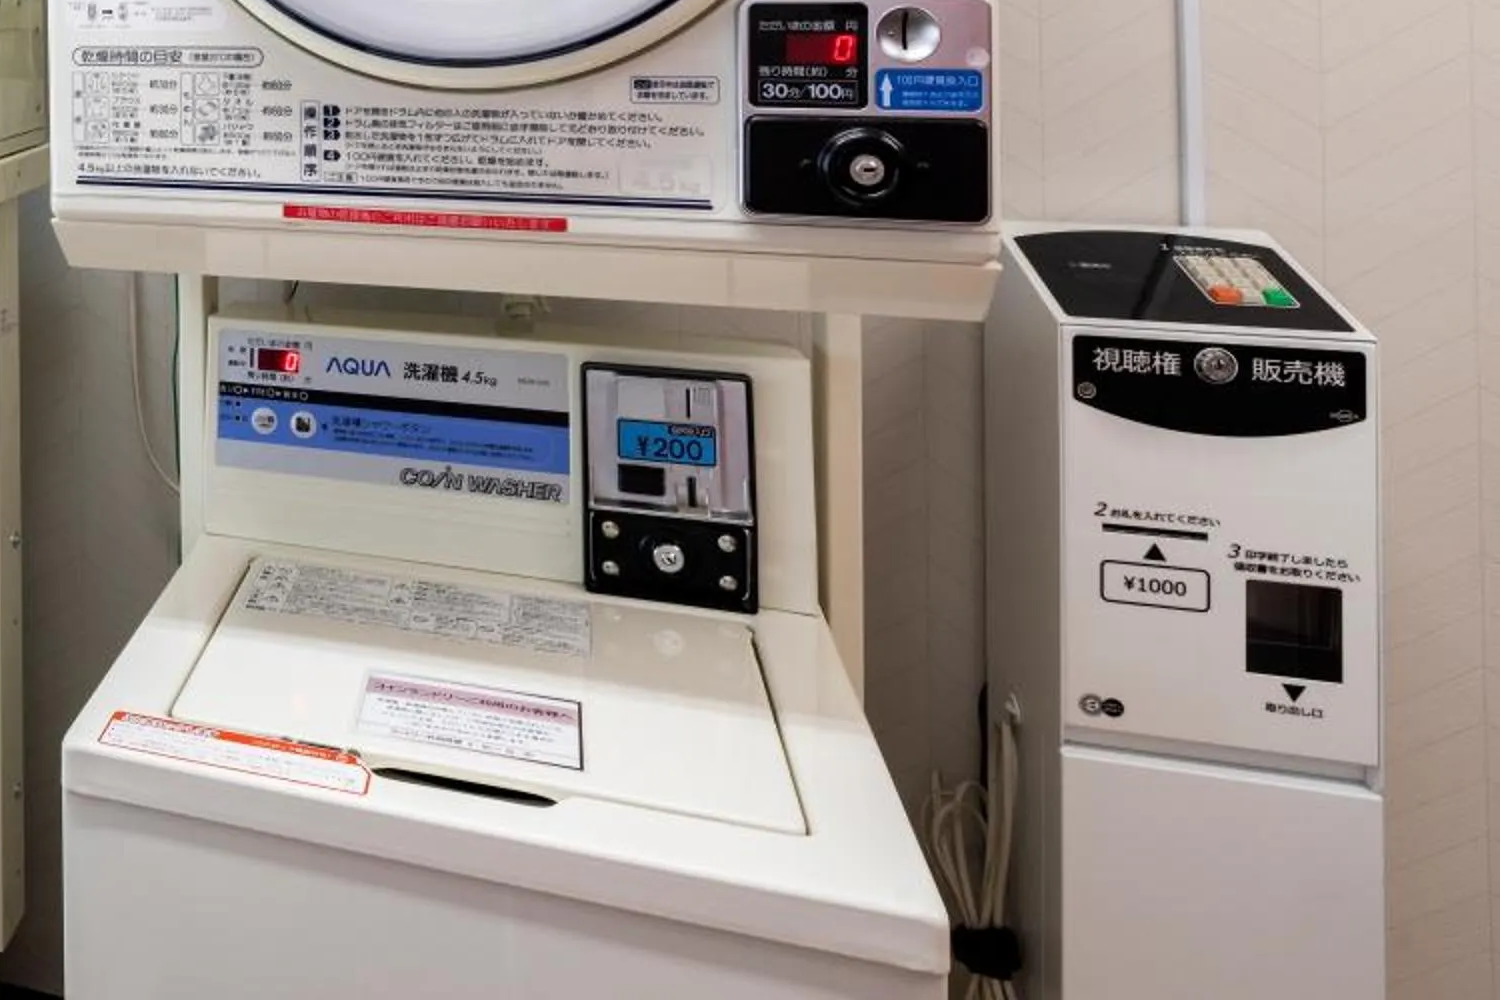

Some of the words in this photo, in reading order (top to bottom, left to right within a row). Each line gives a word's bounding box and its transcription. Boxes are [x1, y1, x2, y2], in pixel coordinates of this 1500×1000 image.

[833, 34, 854, 62] 0
[284, 351, 299, 372] 0
[326, 357, 391, 378] AQUA
[1093, 346, 1182, 377] 視聴権
[1252, 357, 1347, 388] 販売機
[403, 361, 460, 384] 洗濯機
[461, 370, 498, 388] 4.5kg
[636, 436, 704, 461] ¥200
[467, 475, 563, 503] WASHER
[1093, 501, 1108, 517] 2
[1227, 543, 1242, 560] 3
[1123, 575, 1188, 598] ¥1000
